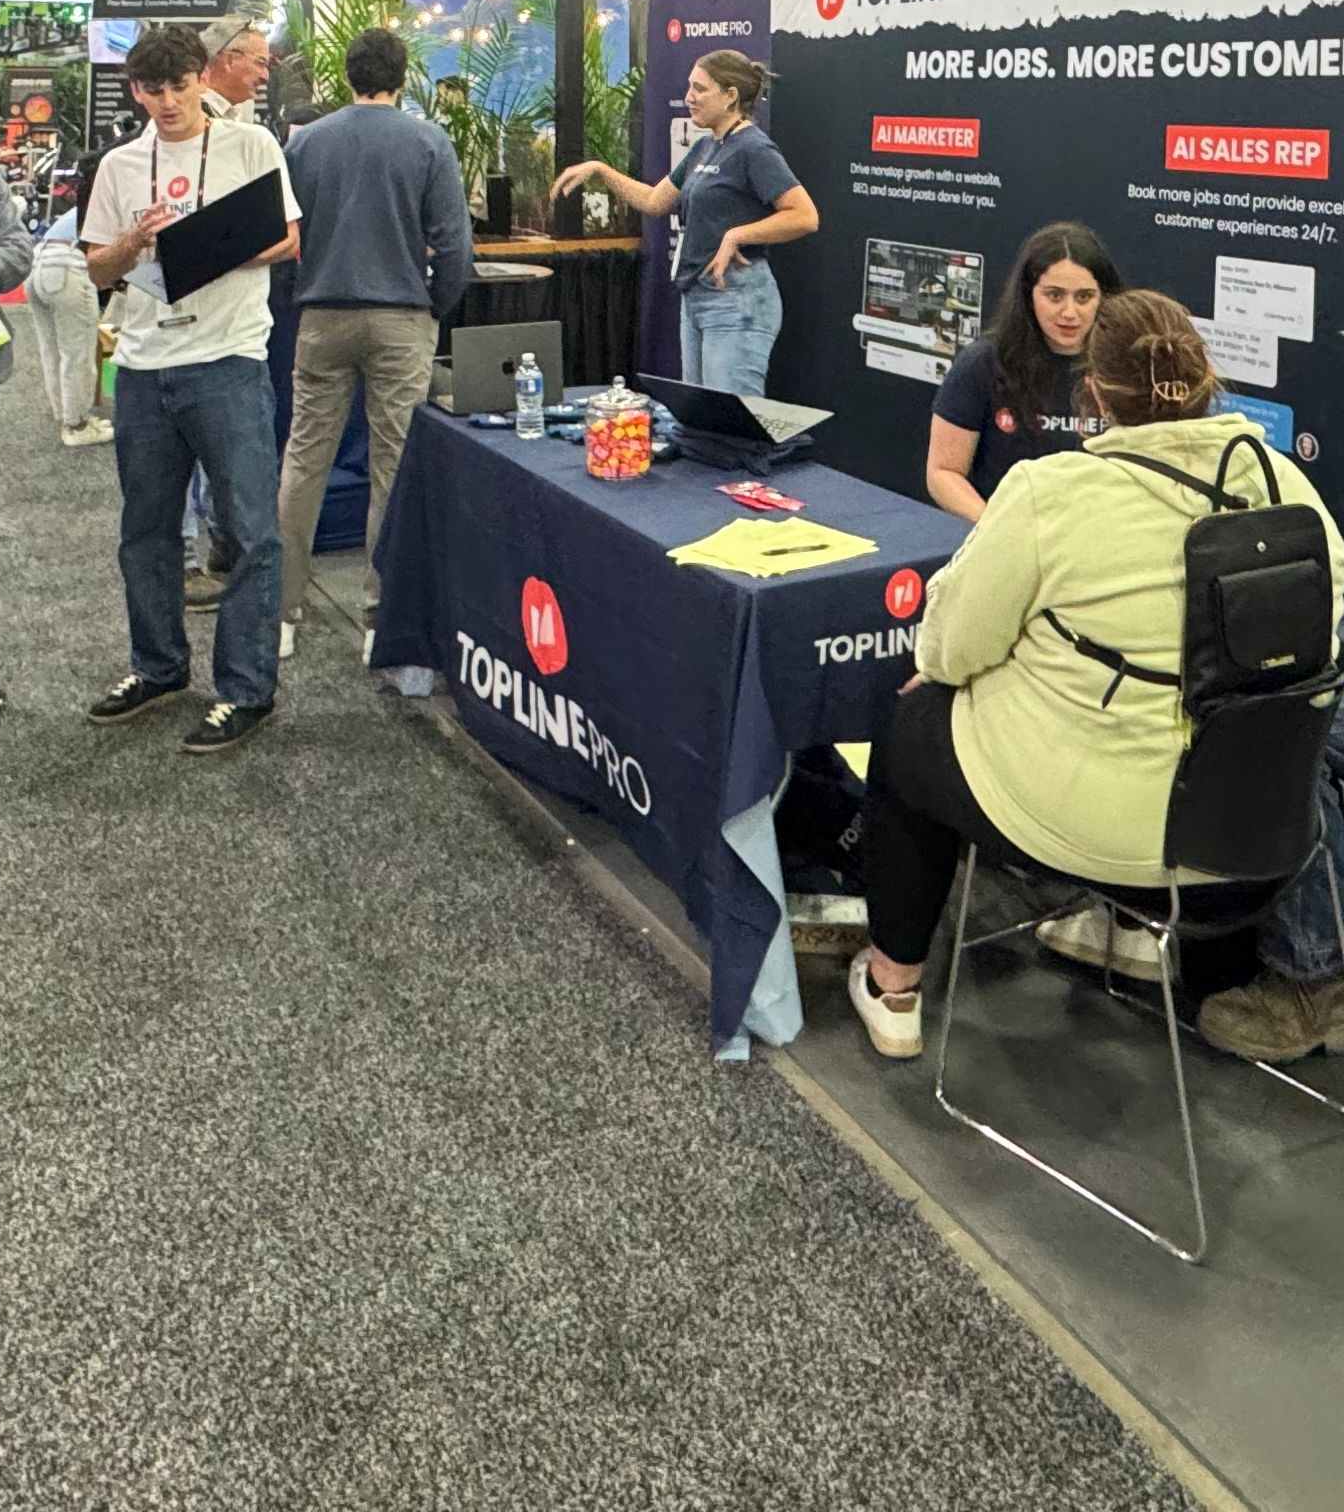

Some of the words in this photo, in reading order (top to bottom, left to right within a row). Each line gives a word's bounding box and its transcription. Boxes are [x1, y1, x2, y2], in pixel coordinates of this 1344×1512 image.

[905, 49, 976, 80] MORE
[978, 47, 1056, 80] JOBS.
[1066, 43, 1155, 79] MORE
[877, 125, 891, 143] AI
[894, 125, 974, 148] MARKETER
[1172, 136, 1195, 160] AI
[1200, 137, 1269, 165] SALES
[1274, 140, 1321, 167] REP
[850, 162, 870, 175] Drive
[905, 168, 935, 182] growth
[936, 170, 954, 182] with
[870, 185, 887, 197] and
[888, 186, 912, 199] social
[912, 189, 936, 202] posts
[937, 191, 960, 204] done
[962, 191, 974, 206] for
[1128, 184, 1157, 201] Book
[1158, 188, 1191, 202] more
[1192, 187, 1221, 208] jobs
[1223, 192, 1250, 208] and
[1252, 194, 1305, 213] provide
[1155, 210, 1214, 230] customer
[1216, 218, 1298, 240] experiences
[814, 625, 915, 665] TOPLIN
